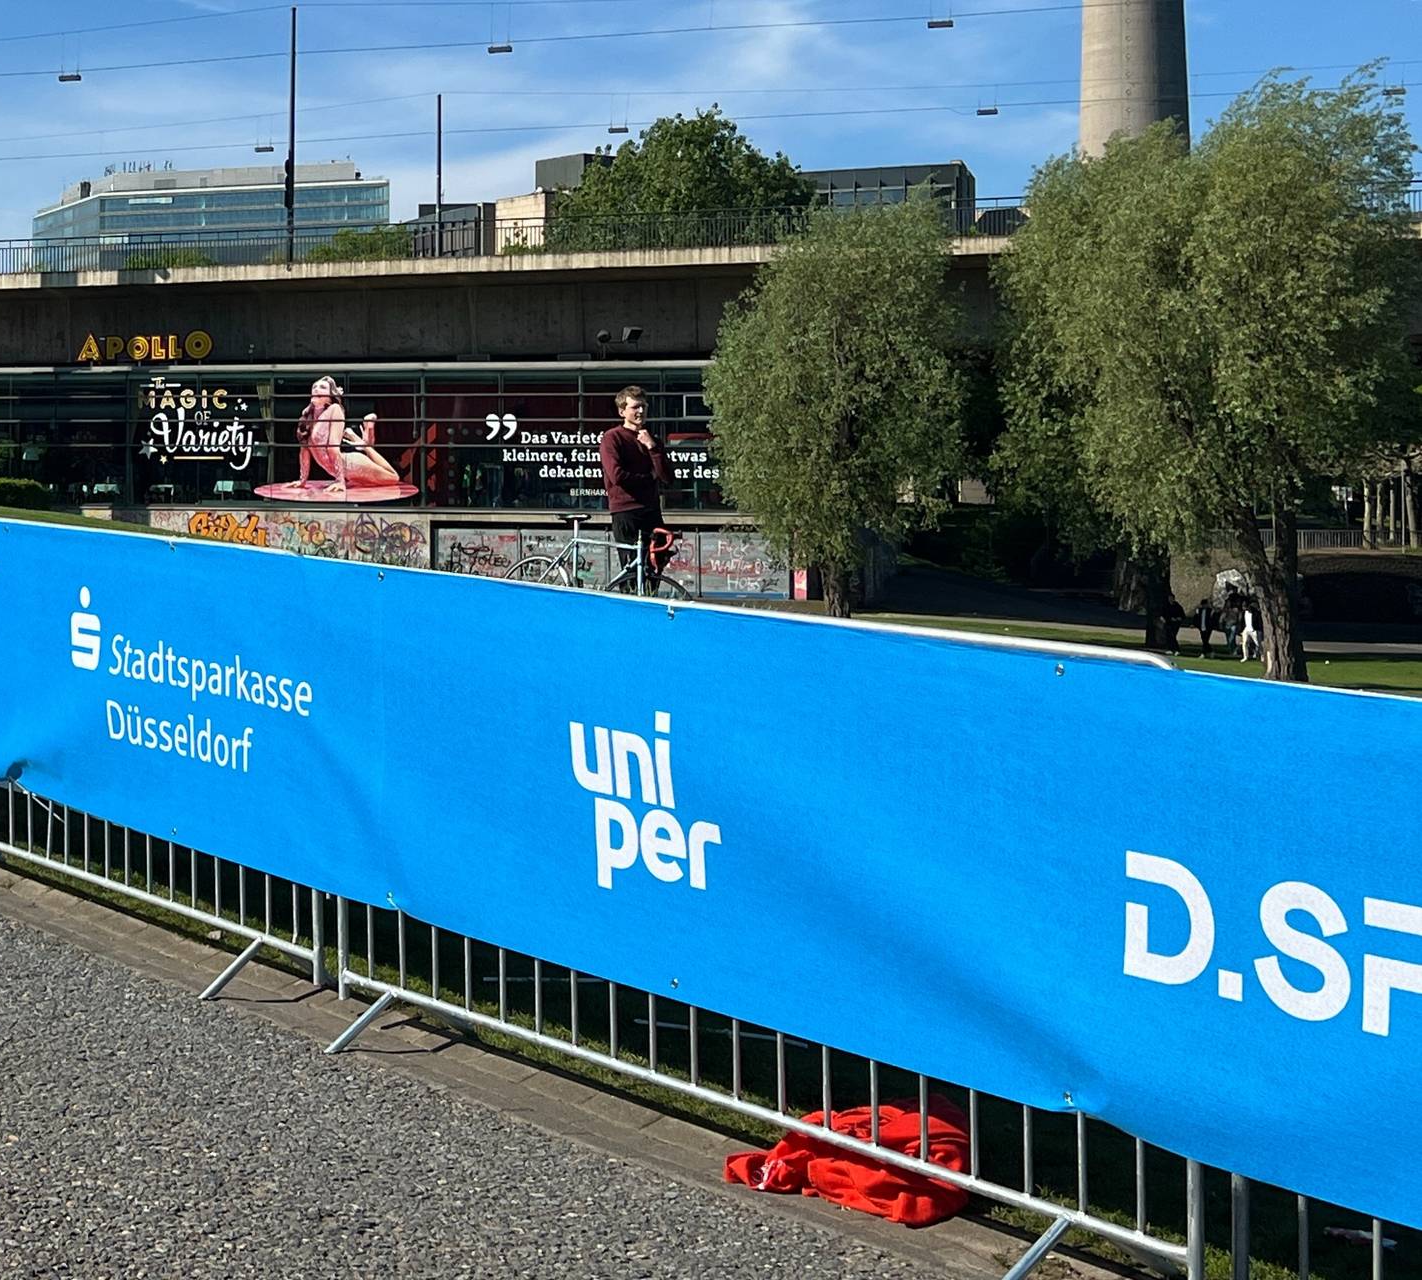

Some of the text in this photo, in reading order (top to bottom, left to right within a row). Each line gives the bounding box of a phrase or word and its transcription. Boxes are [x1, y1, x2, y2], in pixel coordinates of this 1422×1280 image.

[78, 331, 212, 361] APOLLO
[138, 389, 228, 410] MAGIC
[194, 411, 212, 426] OF
[150, 407, 254, 471] Variety
[521, 432, 548, 444] Das
[503, 449, 568, 464] kleinere,
[539, 465, 604, 478] dekaden
[693, 465, 720, 479] des
[109, 634, 313, 717] Stadtsparkasse
[106, 699, 254, 773] Düsseldorf
[569, 710, 676, 809] uni
[594, 797, 722, 890] per
